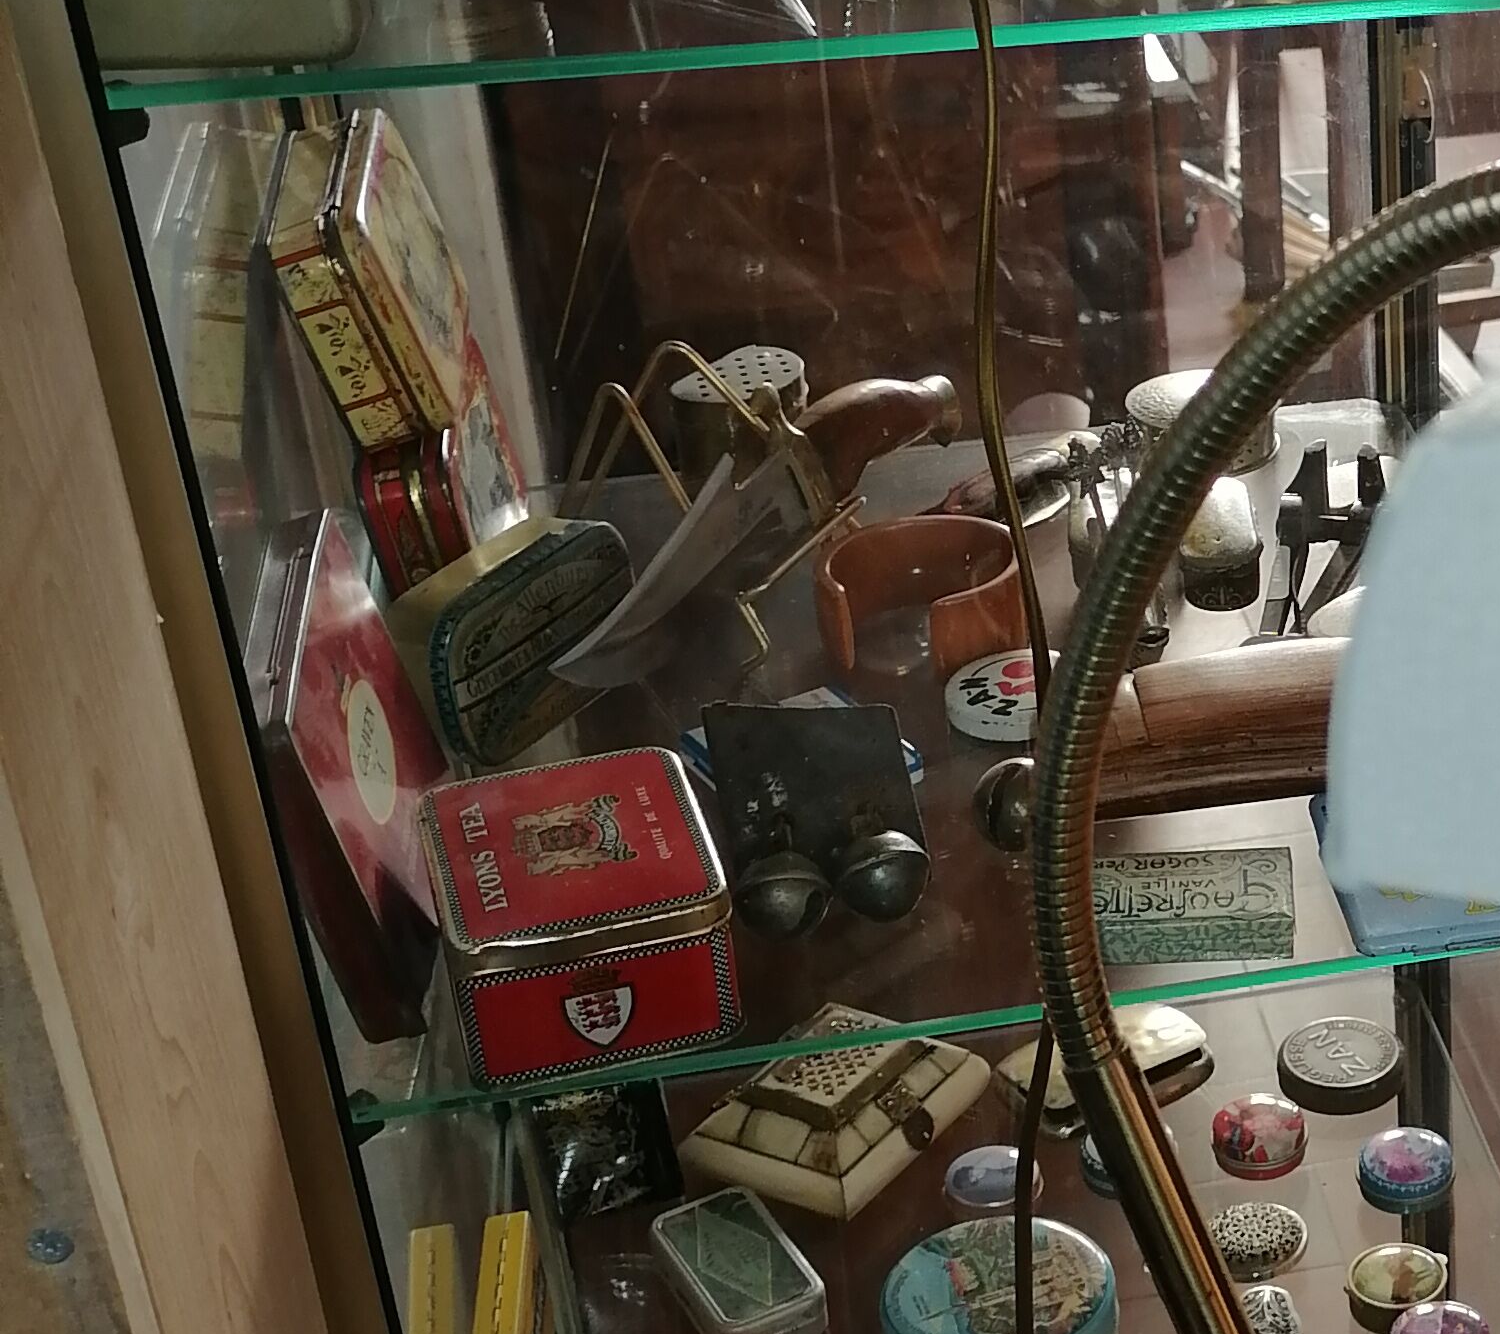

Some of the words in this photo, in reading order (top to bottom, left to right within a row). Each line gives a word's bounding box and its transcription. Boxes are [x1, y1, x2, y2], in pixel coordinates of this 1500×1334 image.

[459, 802, 488, 843] TEA
[471, 851, 509, 913] LYONS
[1141, 878, 1216, 890] VANILLE
[1308, 1027, 1371, 1077] ZAN
